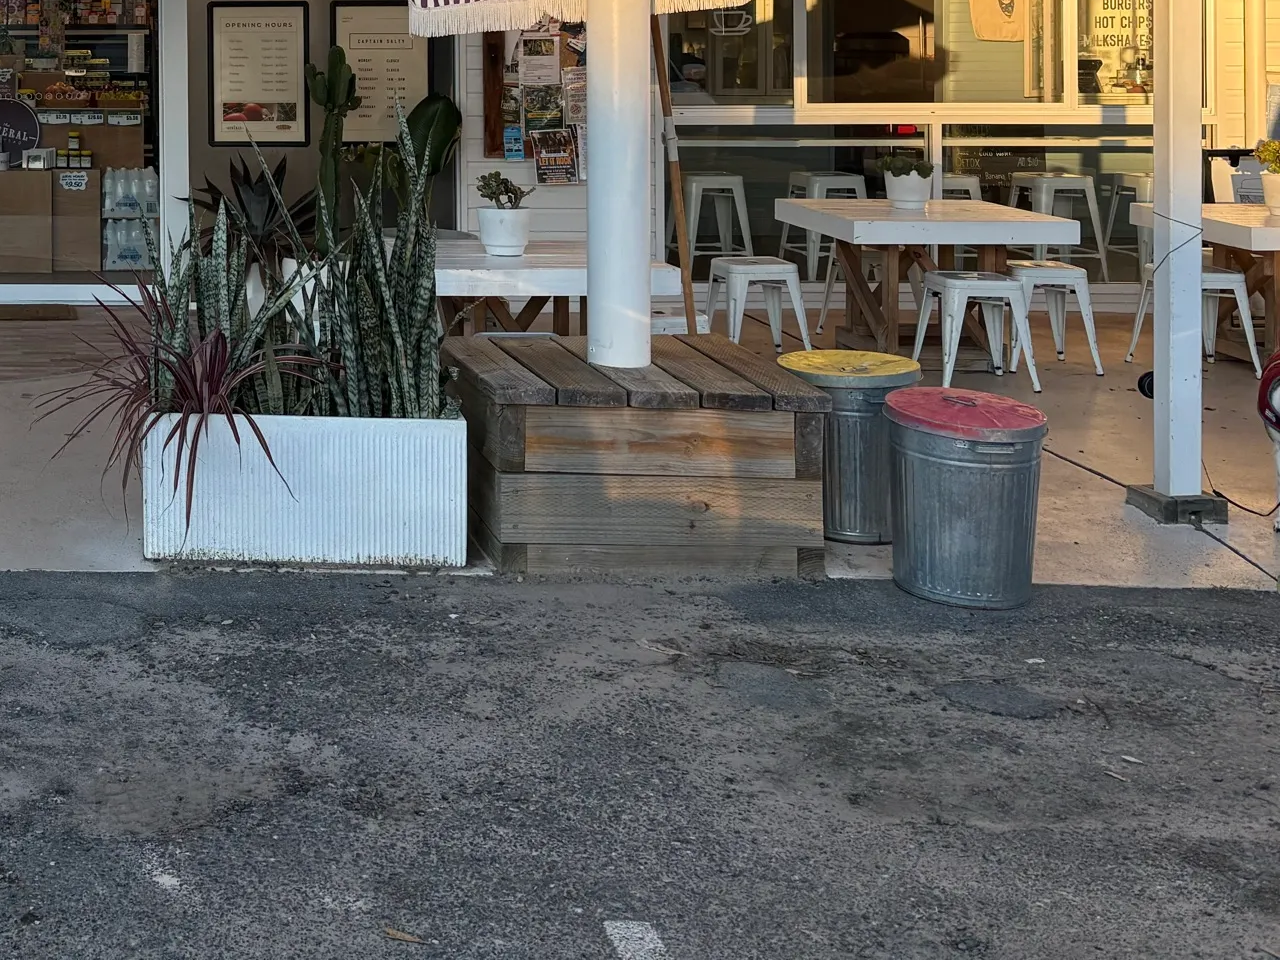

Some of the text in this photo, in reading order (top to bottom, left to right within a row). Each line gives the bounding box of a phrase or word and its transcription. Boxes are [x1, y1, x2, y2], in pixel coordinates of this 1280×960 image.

[1094, 16, 1152, 28] HOT CHIPS
[1082, 34, 1152, 48] MILKSHAKES
[539, 157, 549, 166] LET
